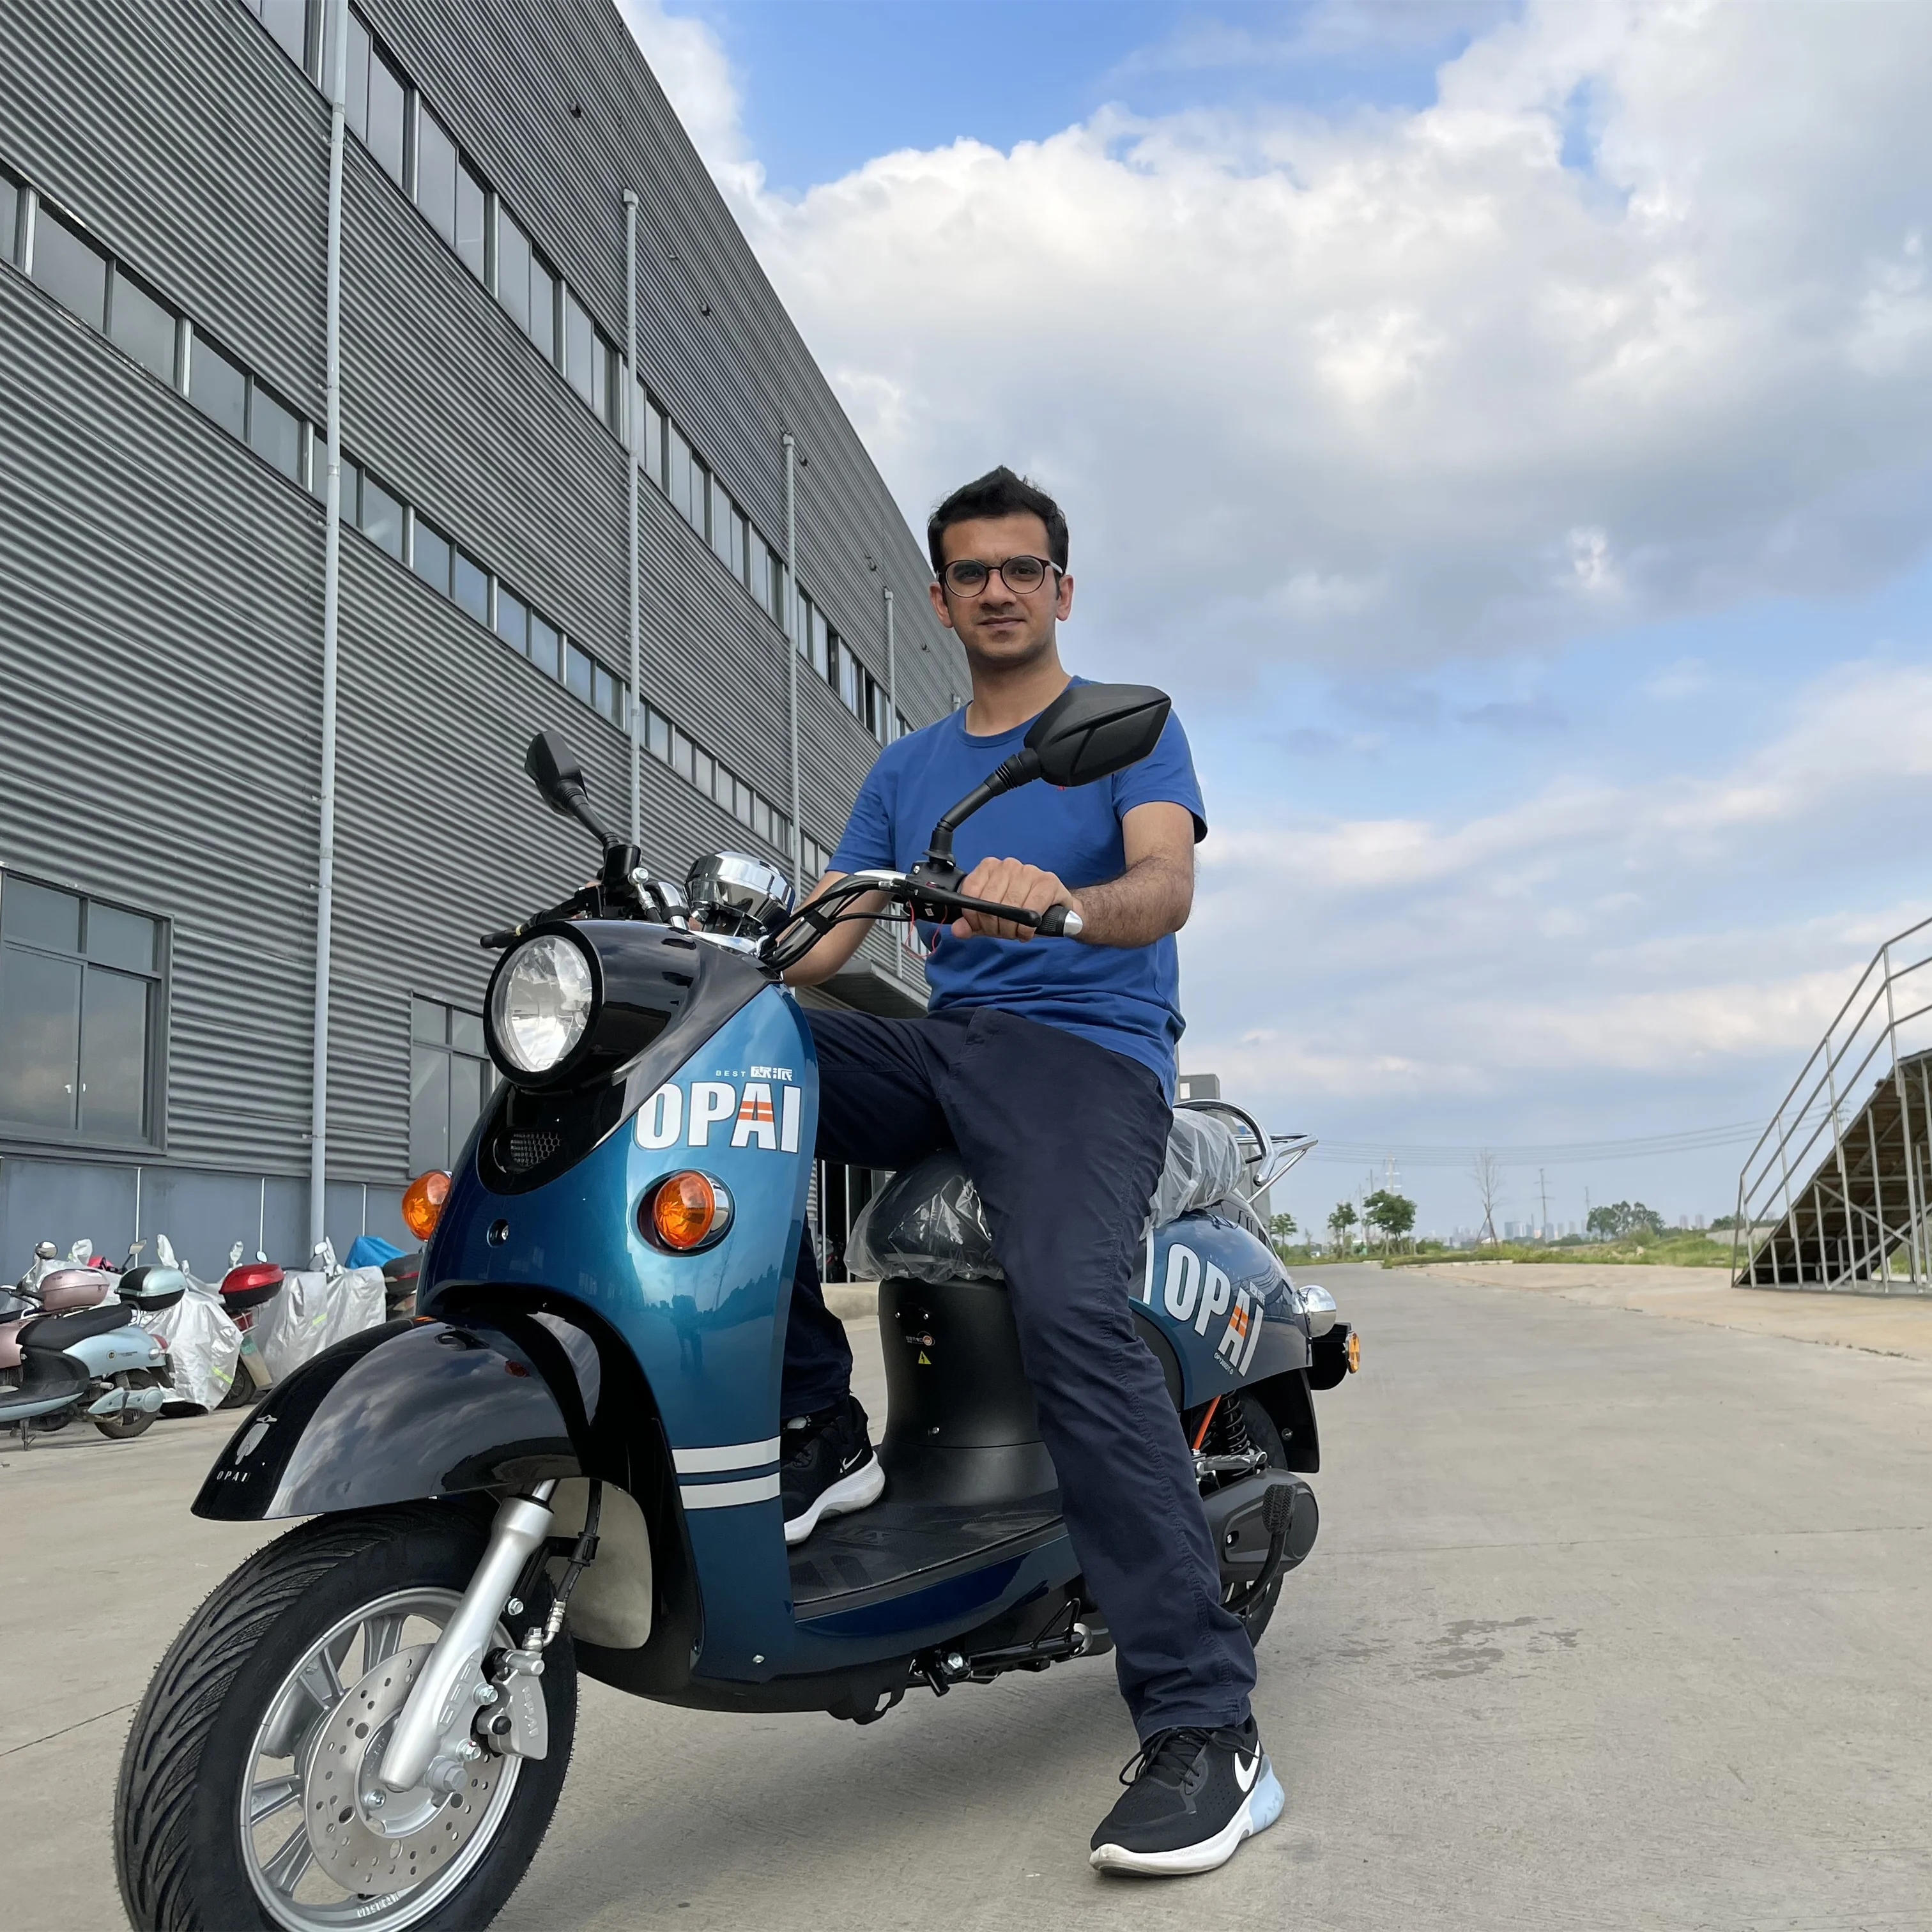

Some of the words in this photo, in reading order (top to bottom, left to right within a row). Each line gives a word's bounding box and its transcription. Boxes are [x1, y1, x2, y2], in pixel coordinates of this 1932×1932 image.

[750, 1066, 792, 1082] 欧派
[636, 1082, 801, 1154] OPAI
[1163, 1243, 1264, 1377] OPAI
[216, 1471, 248, 1482] OPAI
